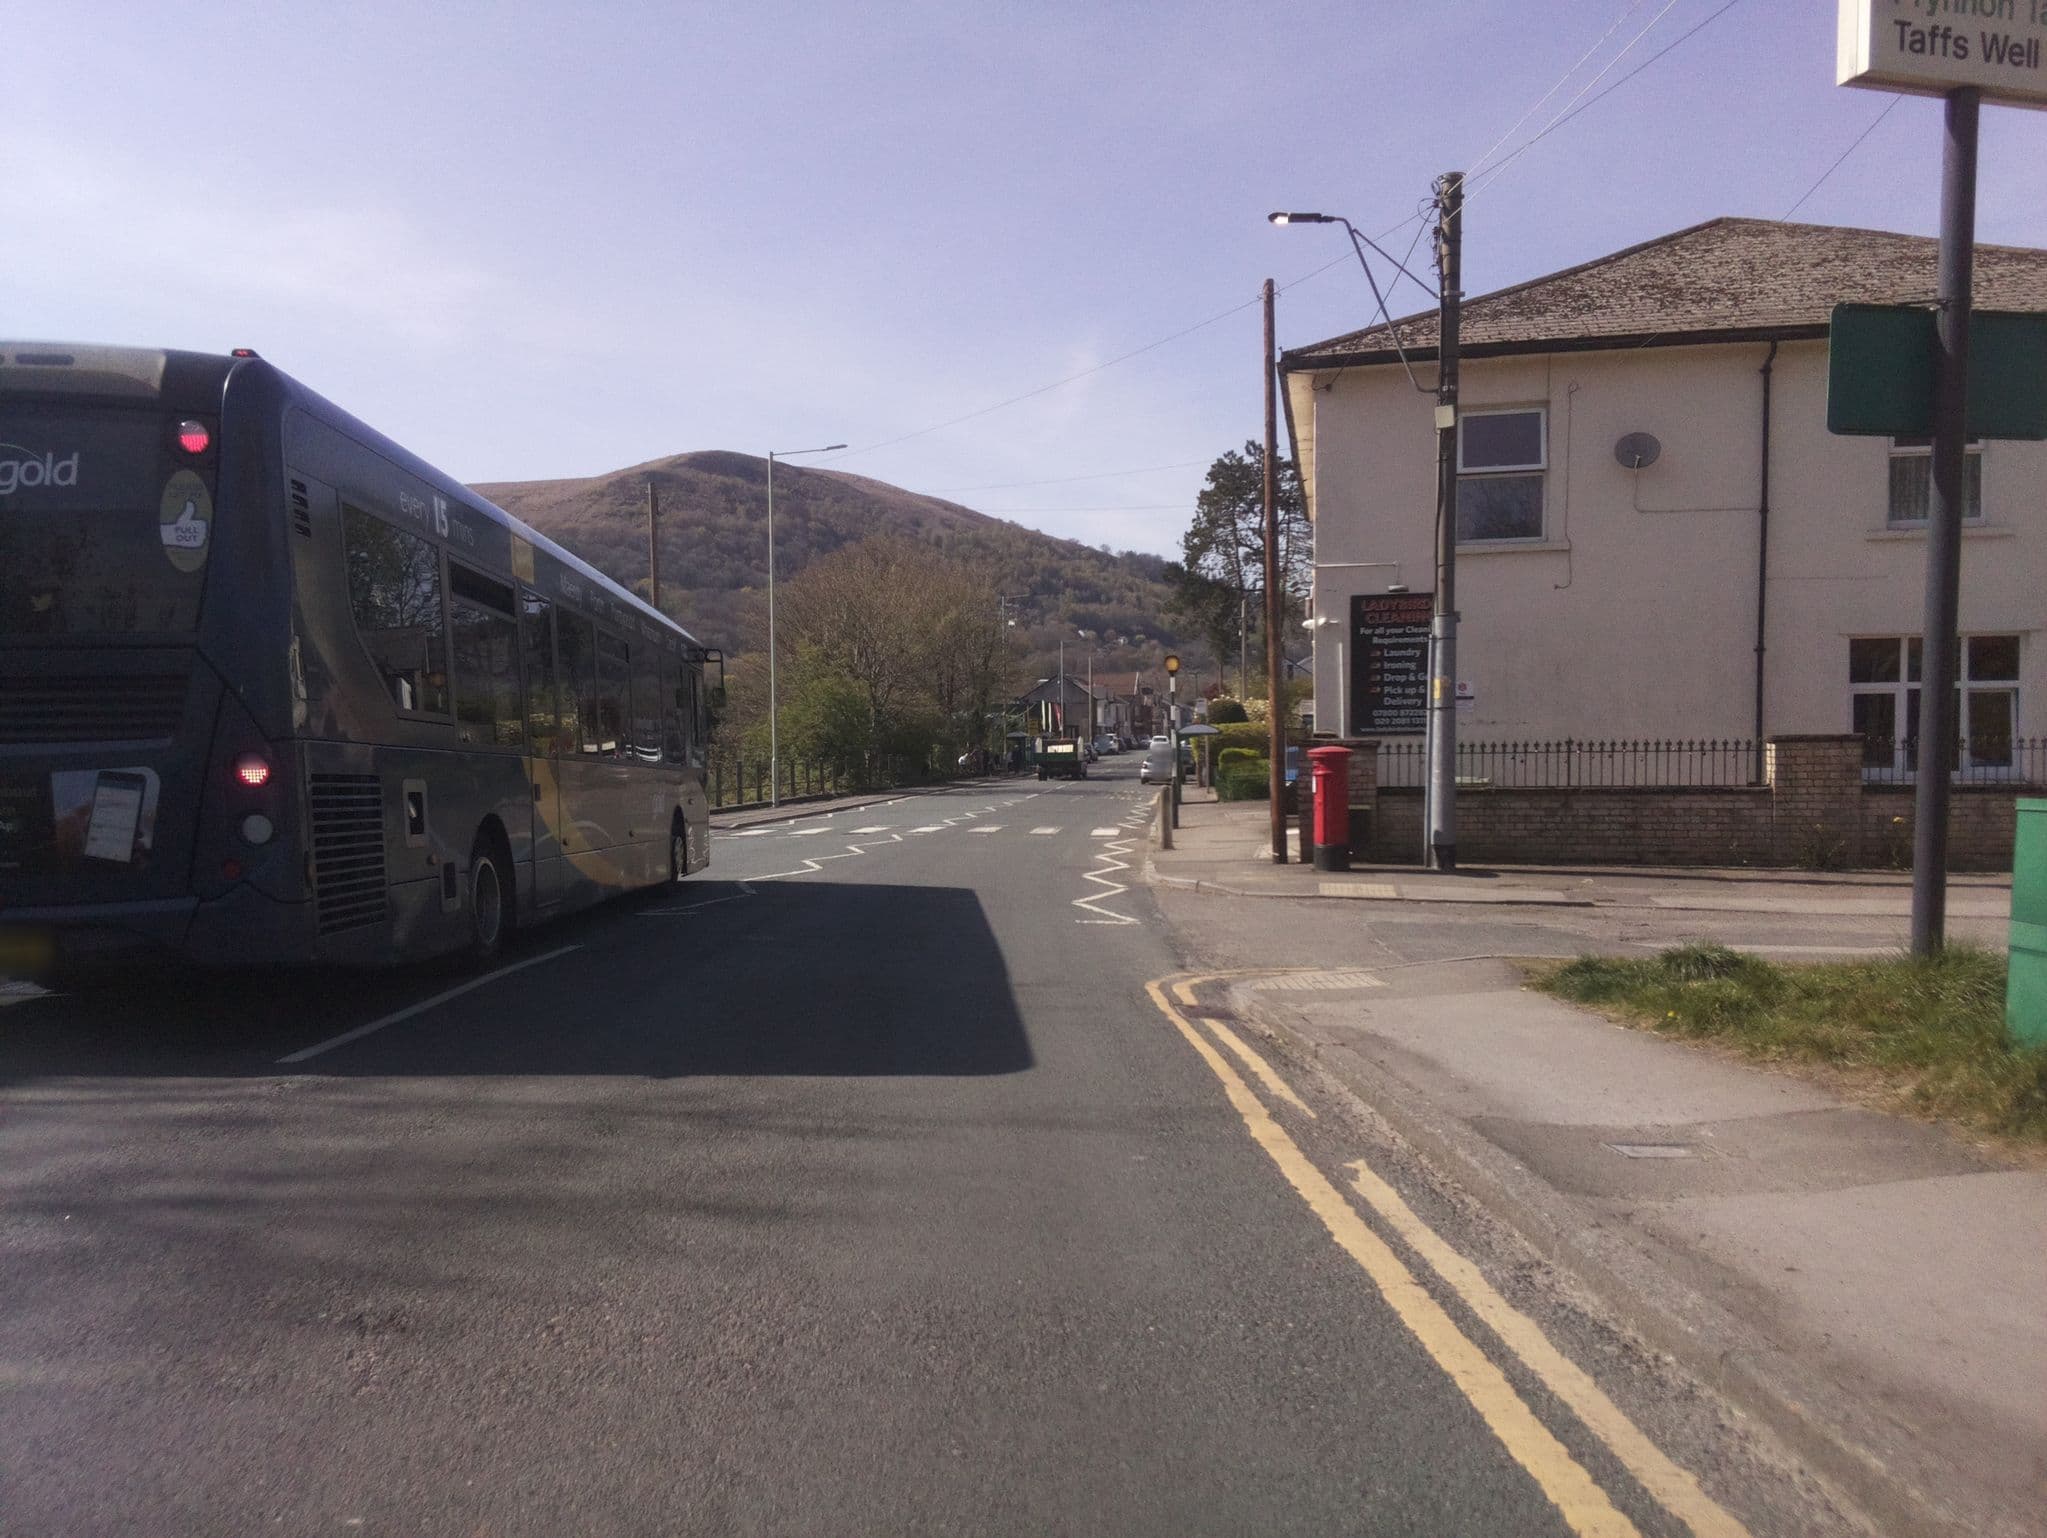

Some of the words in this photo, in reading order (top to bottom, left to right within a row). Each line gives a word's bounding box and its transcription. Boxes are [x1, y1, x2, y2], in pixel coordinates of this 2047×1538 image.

[1893, 19, 1969, 60] Taffs
[1980, 31, 2040, 69] Well
[0, 452, 80, 495] gold
[433, 496, 449, 538] 15
[1360, 627, 1373, 635] For
[1386, 627, 1404, 636] your
[1372, 635, 1428, 645] Requirements
[1384, 648, 1421, 657] Laundry
[1384, 661, 1417, 670] Ironing
[1384, 673, 1407, 683] Drop
[1409, 673, 1415, 681] &
[1384, 686, 1402, 694] Pick
[1405, 687, 1417, 696] up
[1384, 696, 1422, 707] Delivery
